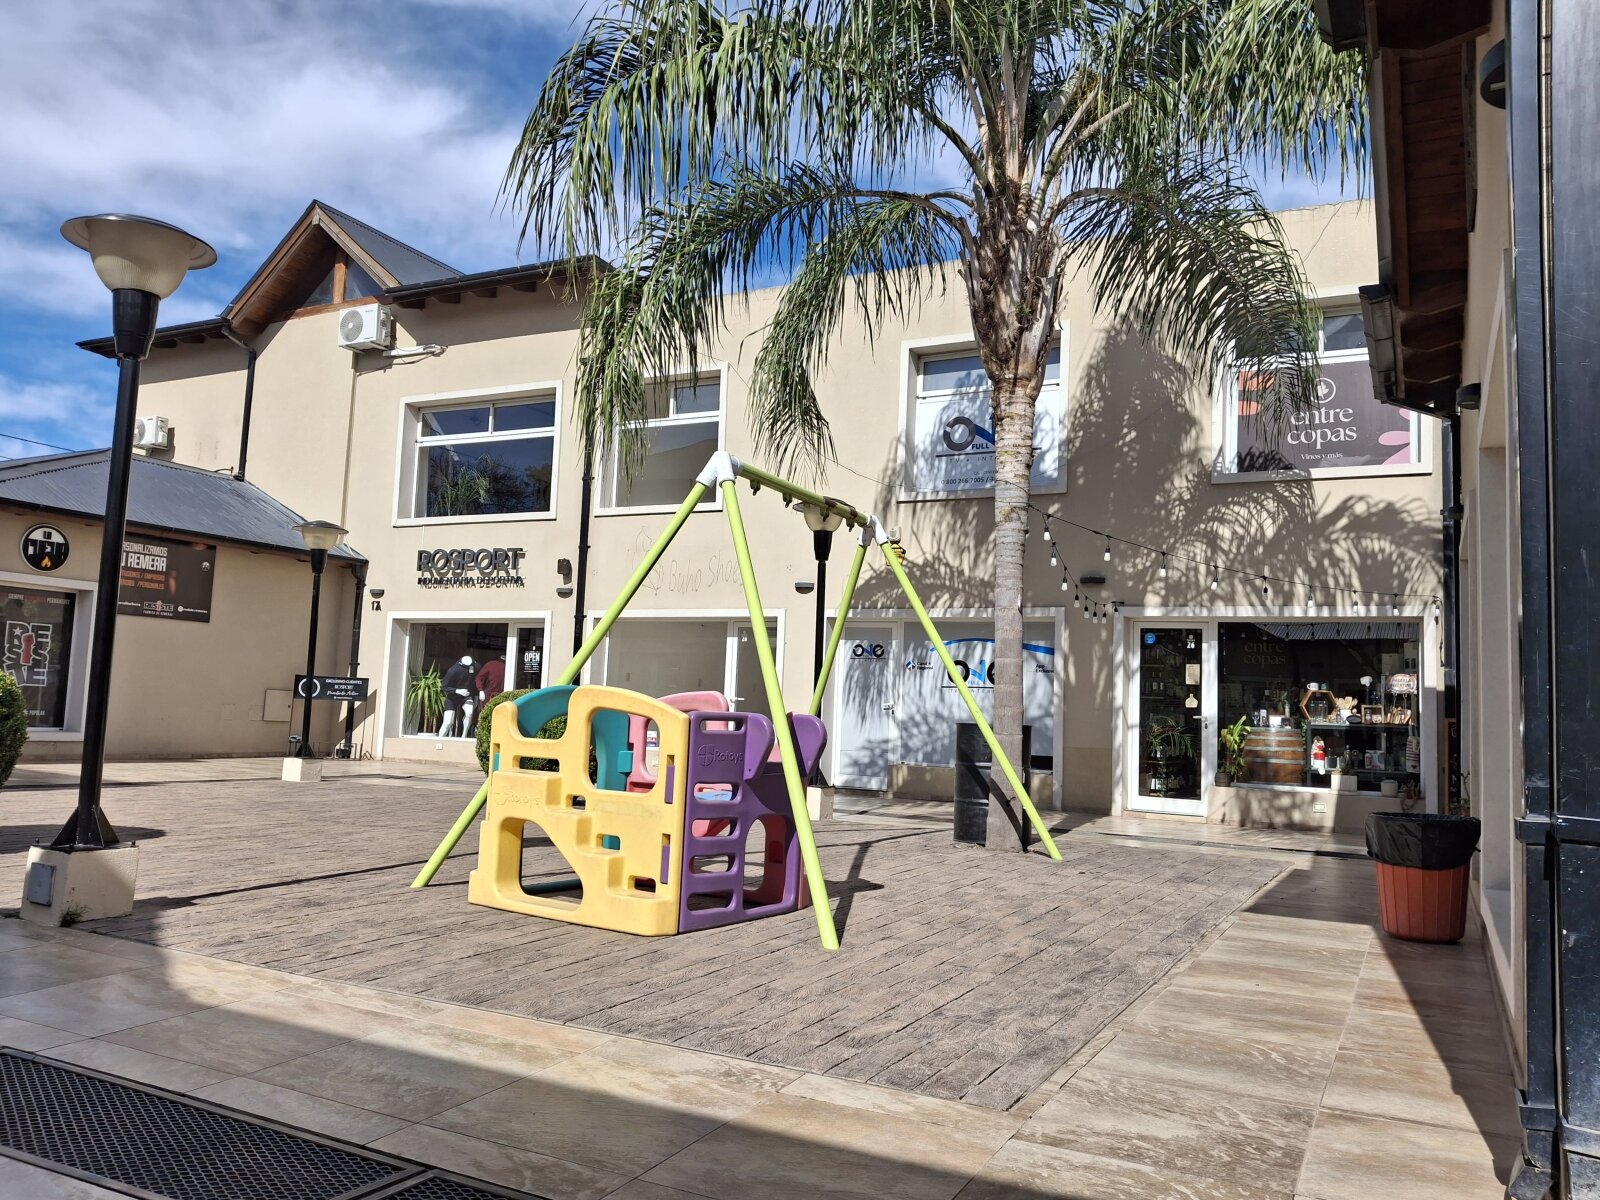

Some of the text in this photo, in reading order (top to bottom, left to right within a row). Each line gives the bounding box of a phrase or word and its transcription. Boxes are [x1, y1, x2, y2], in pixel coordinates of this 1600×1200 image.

[1291, 406, 1354, 426] entre
[1287, 426, 1357, 450] copas
[1301, 453, 1320, 461] Vinos
[127, 553, 167, 572] REMERA
[417, 548, 524, 573] ROSPORT
[476, 575, 524, 585] DEPORTIVA
[524, 652, 540, 662] OPEN
